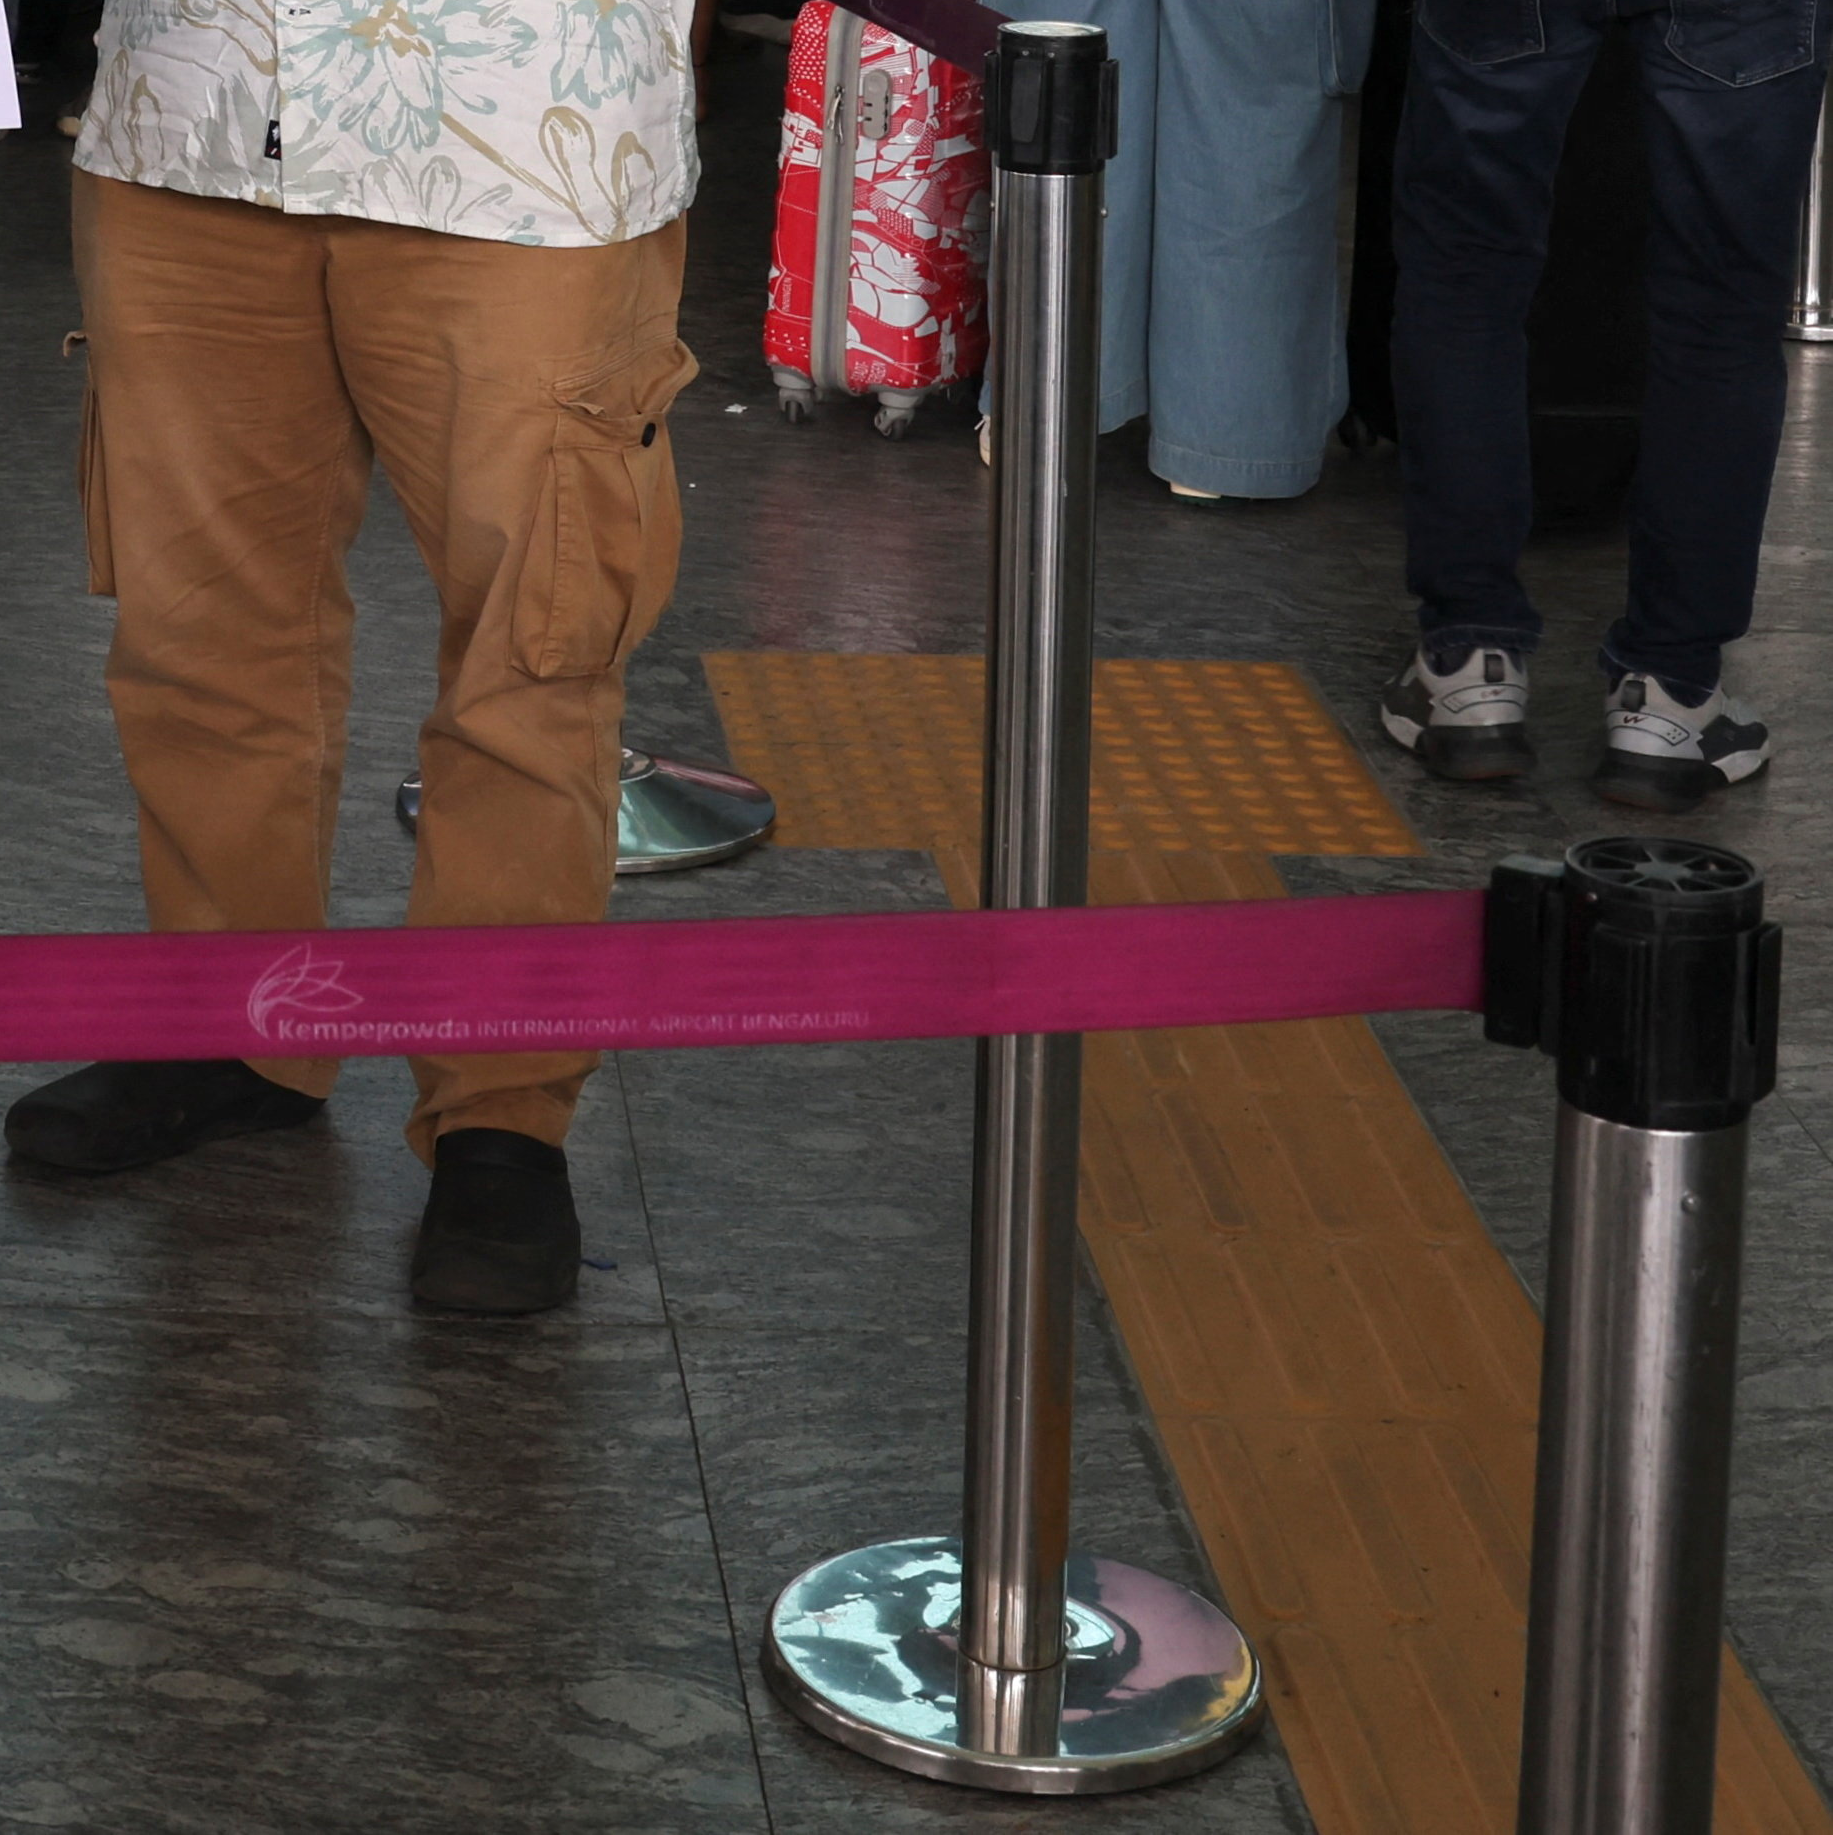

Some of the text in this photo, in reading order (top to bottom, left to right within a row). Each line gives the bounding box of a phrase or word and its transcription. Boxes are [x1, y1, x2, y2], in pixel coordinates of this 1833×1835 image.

[276, 1010, 871, 1045] Kempegowda INTERNATIONAL AIRPORT BENGALURU
